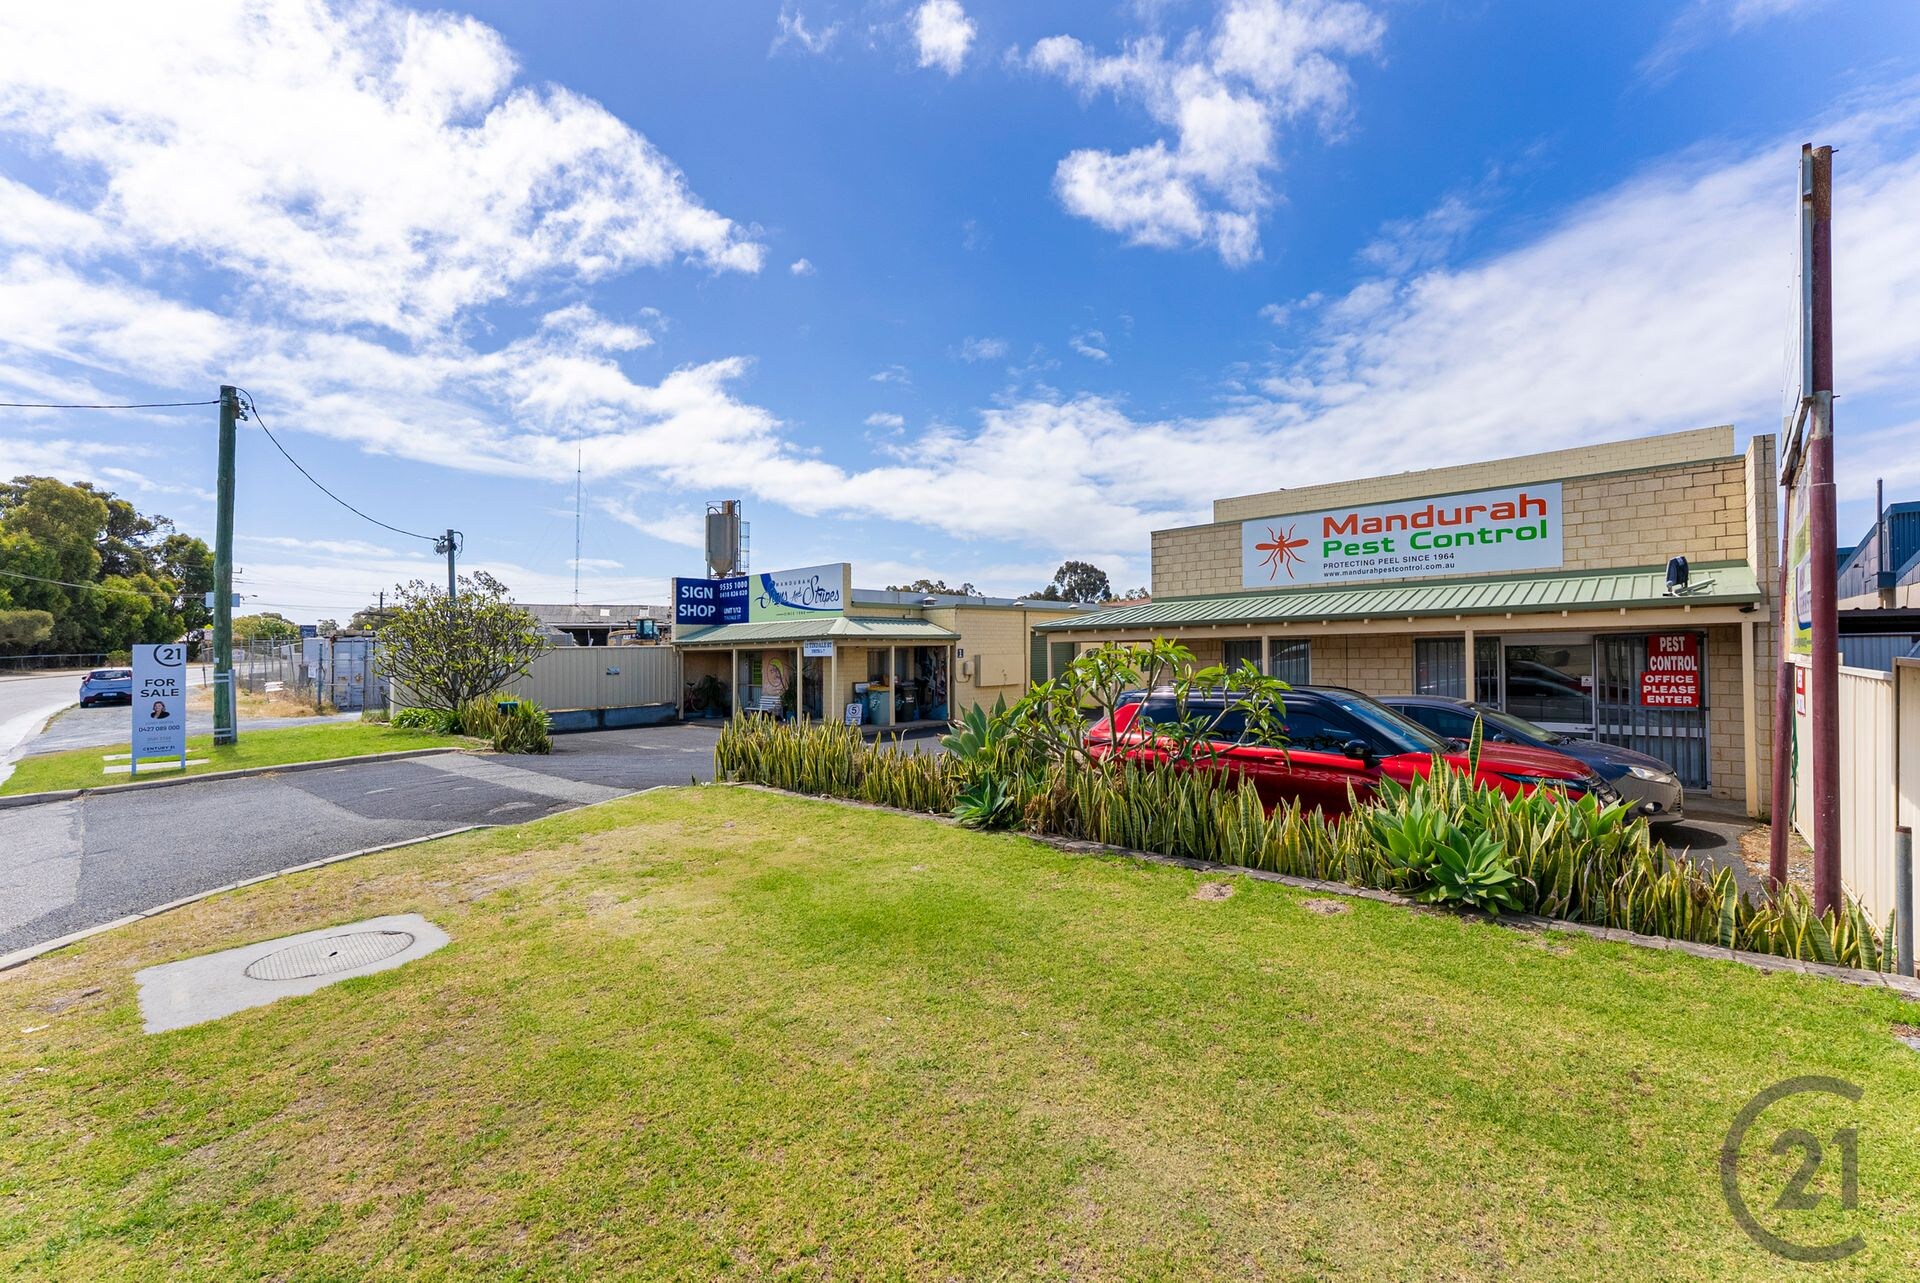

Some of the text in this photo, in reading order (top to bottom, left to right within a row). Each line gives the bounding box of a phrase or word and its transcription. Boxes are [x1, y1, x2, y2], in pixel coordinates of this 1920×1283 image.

[1323, 493, 1547, 539] Mandurah
[1323, 519, 1547, 558] Pest Control
[1323, 552, 1455, 569] PROTECTING PEEL SINCE 1964
[1323, 562, 1455, 578] www.mandurahpestcontrol.com.au
[719, 580, 748, 591] 9535 1000
[802, 575, 840, 606] Stripes
[681, 586, 713, 599] SIGN
[679, 604, 716, 617] SHOP
[1660, 636, 1685, 652] PEST
[1649, 655, 1698, 671] CONTROL
[145, 679, 175, 687] FOR
[1645, 675, 1694, 683] OFFICE
[140, 688, 180, 697] SALE
[1643, 685, 1696, 694] PLEASE
[1646, 695, 1692, 704] ENTER
[851, 706, 857, 714] 5
